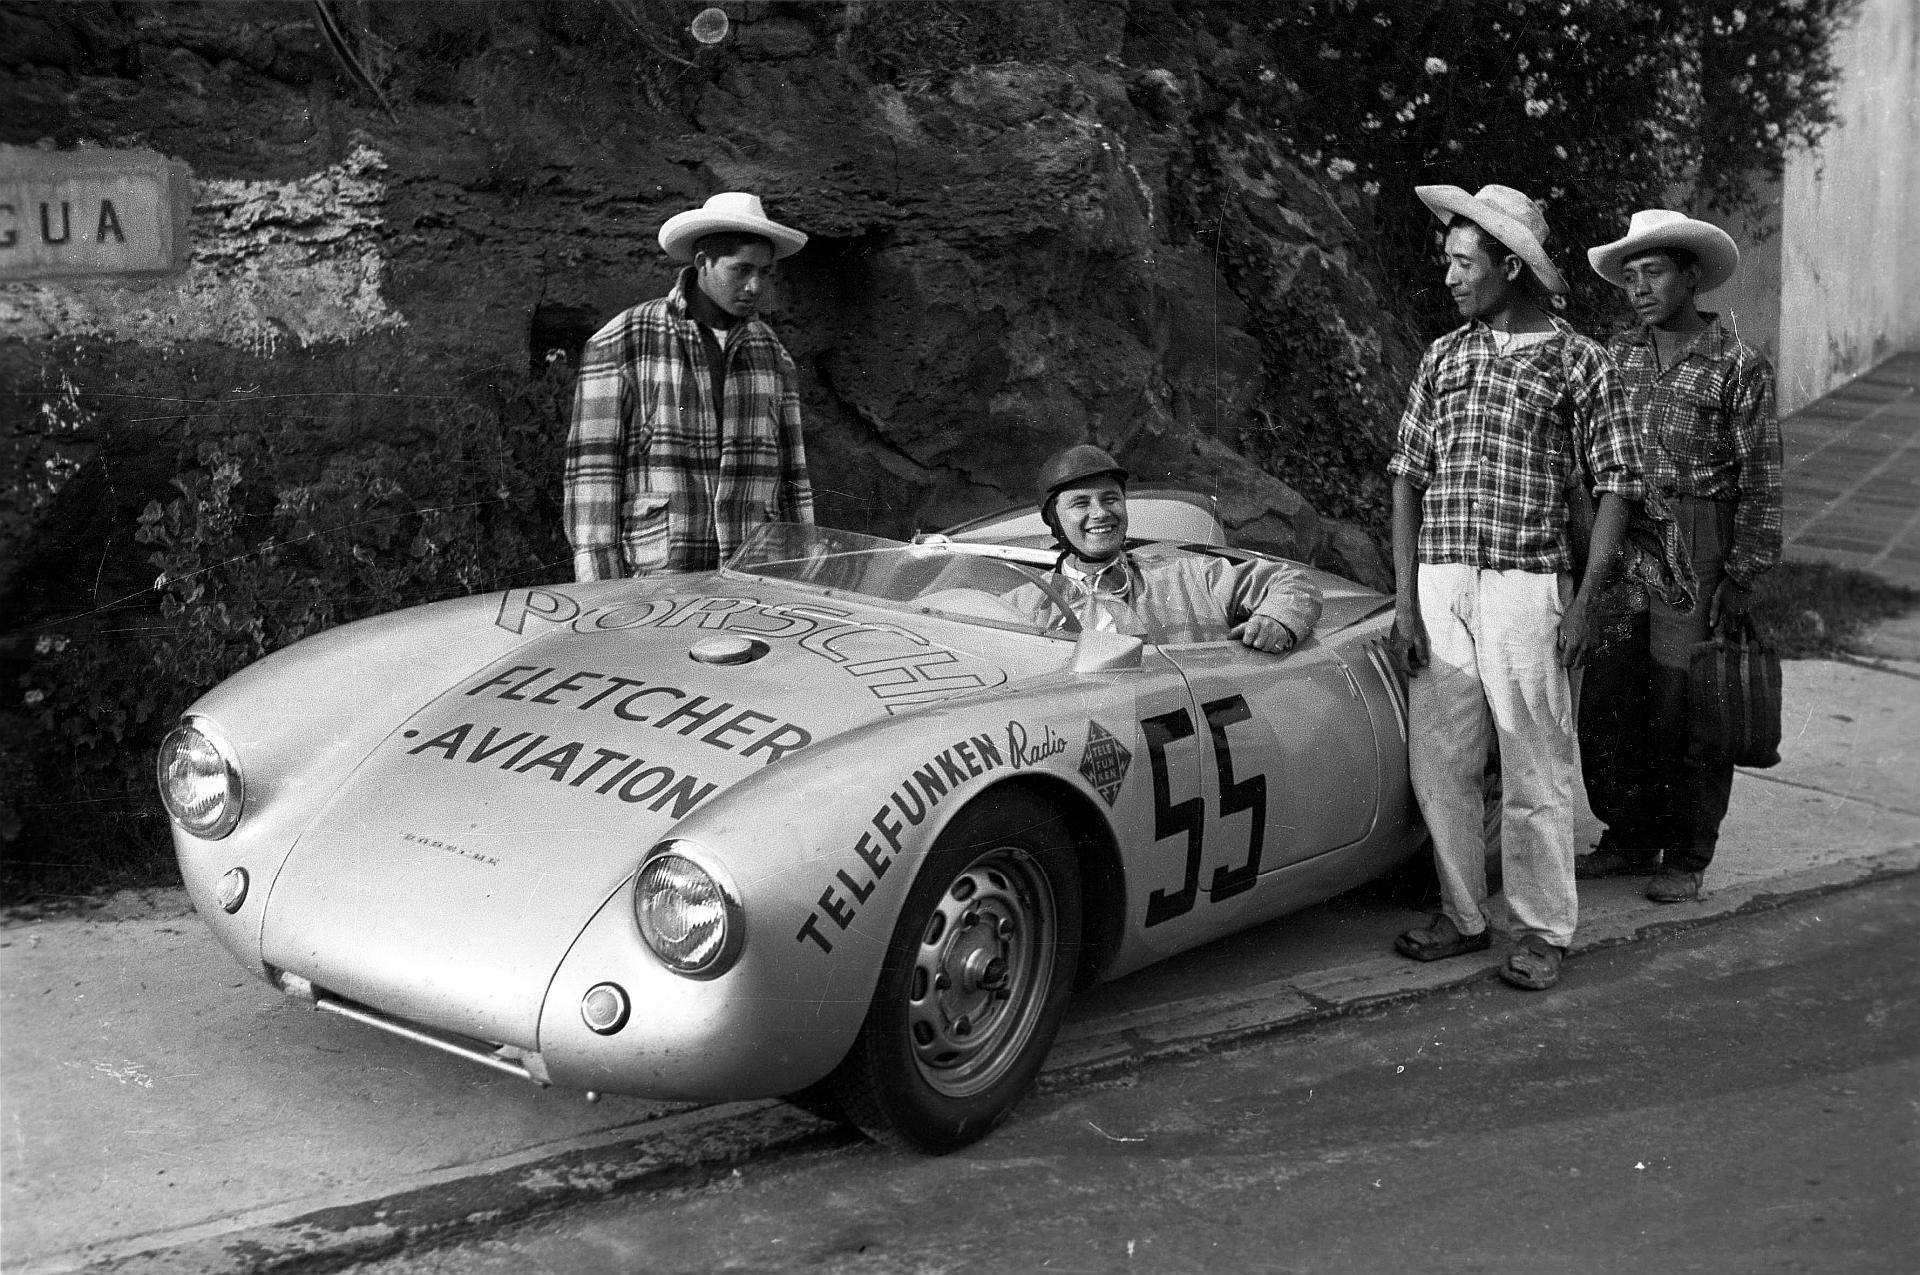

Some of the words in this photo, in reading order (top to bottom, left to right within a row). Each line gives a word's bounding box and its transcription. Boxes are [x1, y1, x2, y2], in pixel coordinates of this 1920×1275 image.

[465, 665, 812, 764] FLETCHER
[1093, 744, 1112, 757] TELE
[406, 722, 718, 820] AVIATION
[1096, 758, 1115, 770] FUN
[1098, 769, 1117, 781] KEN
[1140, 693, 1265, 928] 55
[796, 733, 1004, 954] TELEFUNKEN
[1006, 720, 1067, 769] Radio
